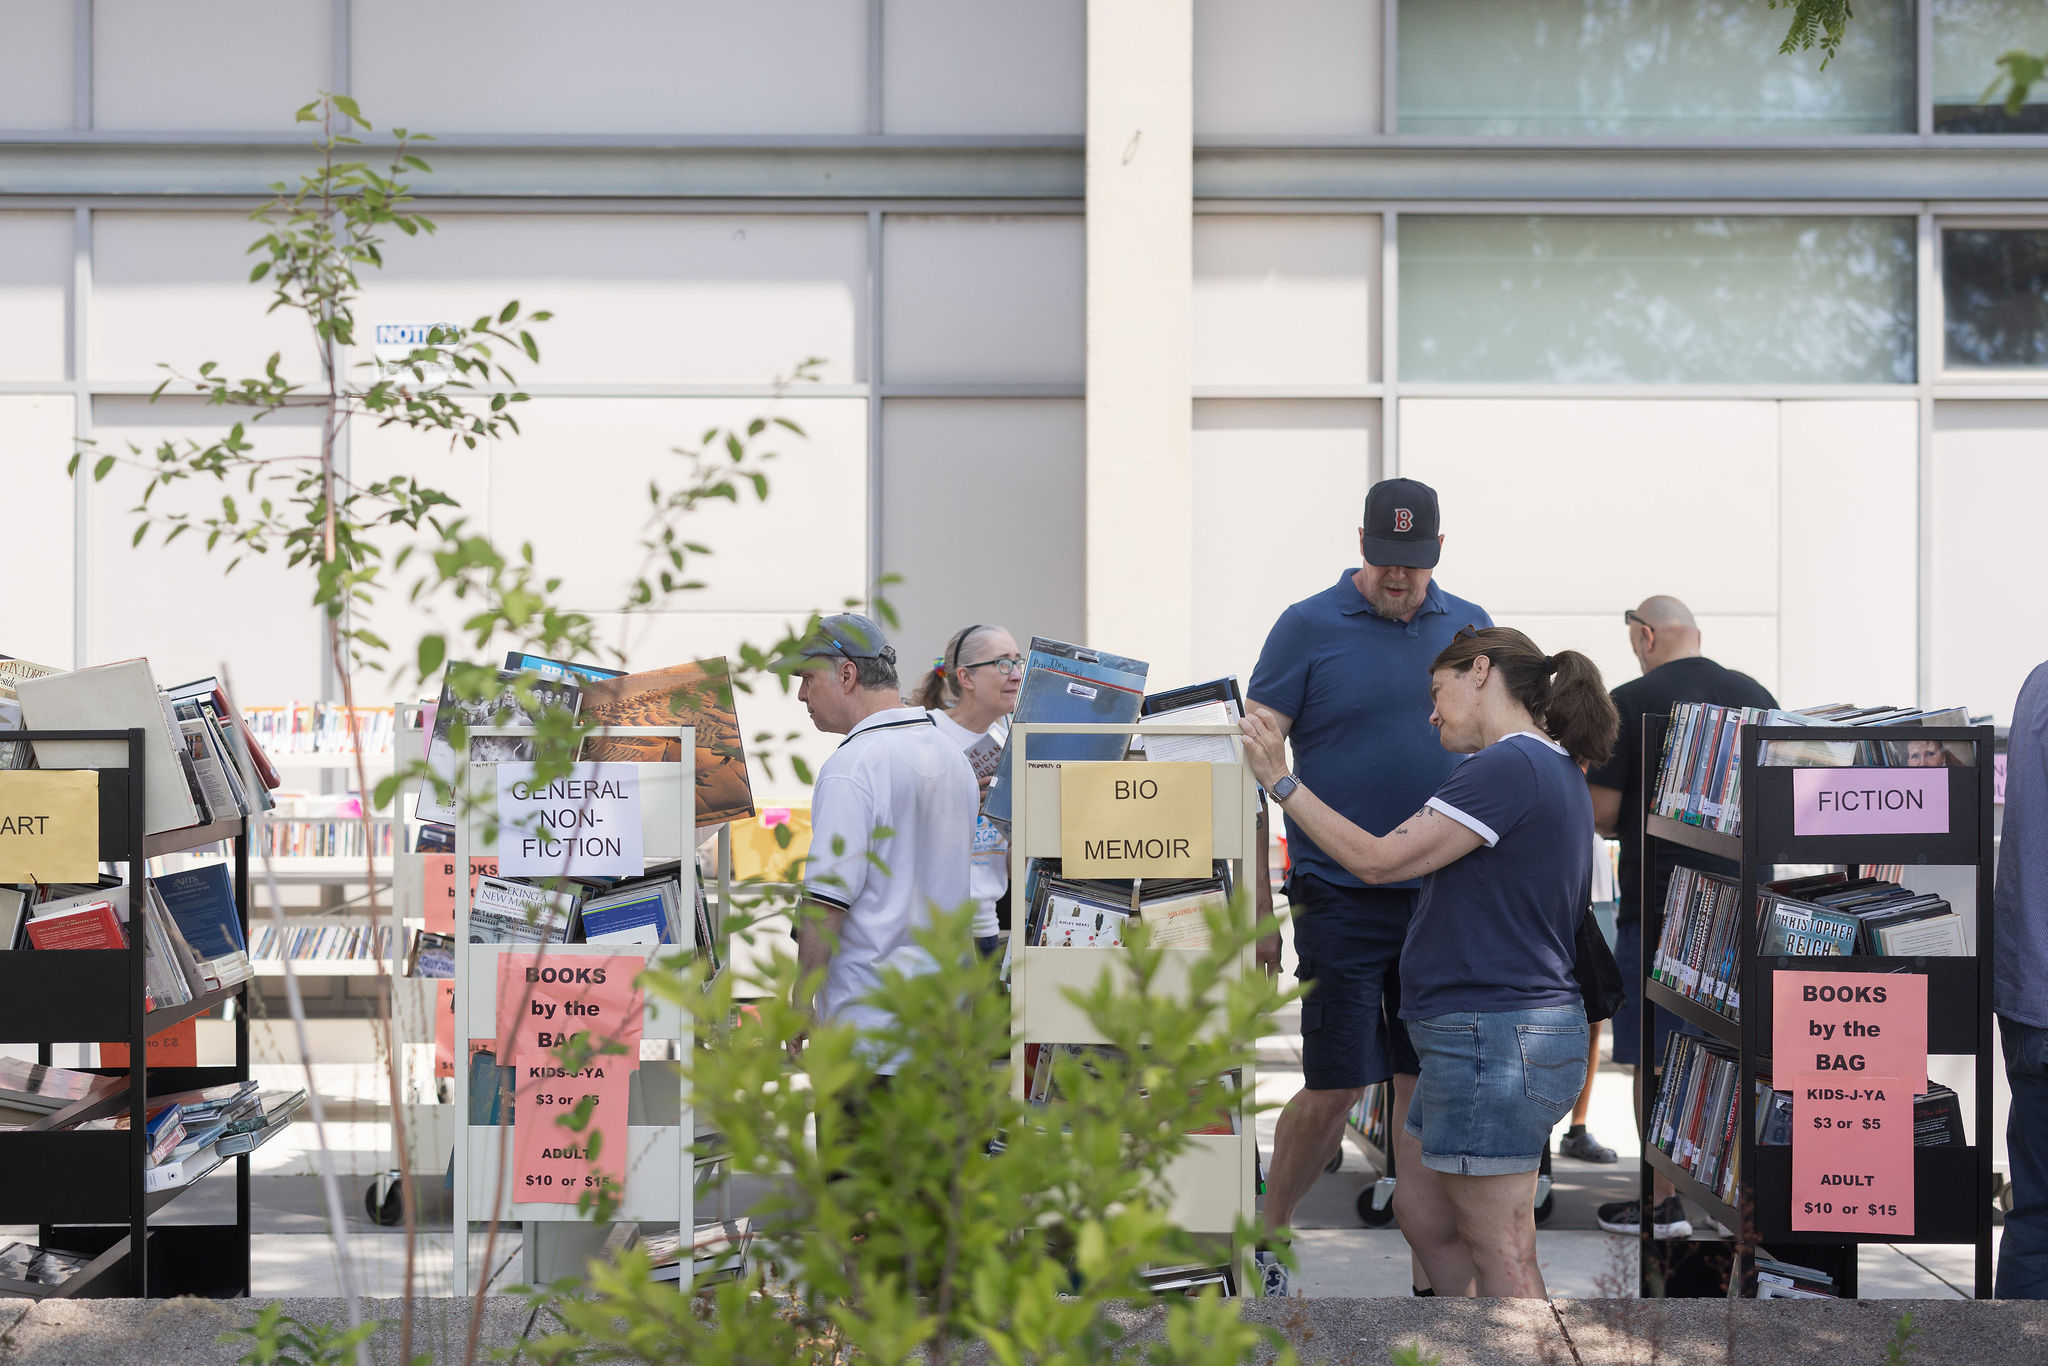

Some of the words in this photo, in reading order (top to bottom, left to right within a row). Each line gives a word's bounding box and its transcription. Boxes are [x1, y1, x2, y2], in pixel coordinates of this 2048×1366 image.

[1393, 508, 1413, 532] B
[512, 780, 629, 800] GENERAL
[1115, 780, 1158, 800] BIO
[1818, 789, 1923, 812] FICTION
[0, 816, 49, 835] ART
[541, 809, 603, 829] NON-
[523, 837, 621, 857] FICTION
[1085, 838, 1190, 860] MEMOIR
[444, 864, 498, 875] BOKS
[482, 890, 507, 906] NEW
[1773, 913, 1854, 941] CHRISTOPHER
[1785, 934, 1831, 956] REICH
[525, 967, 606, 984] BOOKS
[1802, 985, 1887, 1003] BOOKS
[531, 1000, 557, 1020] by
[564, 1000, 600, 1016] the
[1809, 1020, 1836, 1040] by
[1843, 1020, 1880, 1037] the
[1816, 1054, 1865, 1071] BAG
[536, 1094, 554, 1106] $3
[558, 1096, 573, 1105] or
[1807, 1088, 1886, 1101] KIDS-J-YA
[1814, 1117, 1832, 1130] $3
[1837, 1119, 1852, 1129] or
[1862, 1117, 1881, 1130] $5
[542, 1148, 592, 1160] ADULT
[525, 1174, 553, 1187] $10
[561, 1177, 577, 1186] or
[584, 1175, 610, 1188] $15
[1820, 1174, 1874, 1187] ADULT
[1804, 1202, 1833, 1215] $10
[1842, 1204, 1858, 1215] or
[1868, 1203, 1897, 1217] $15
